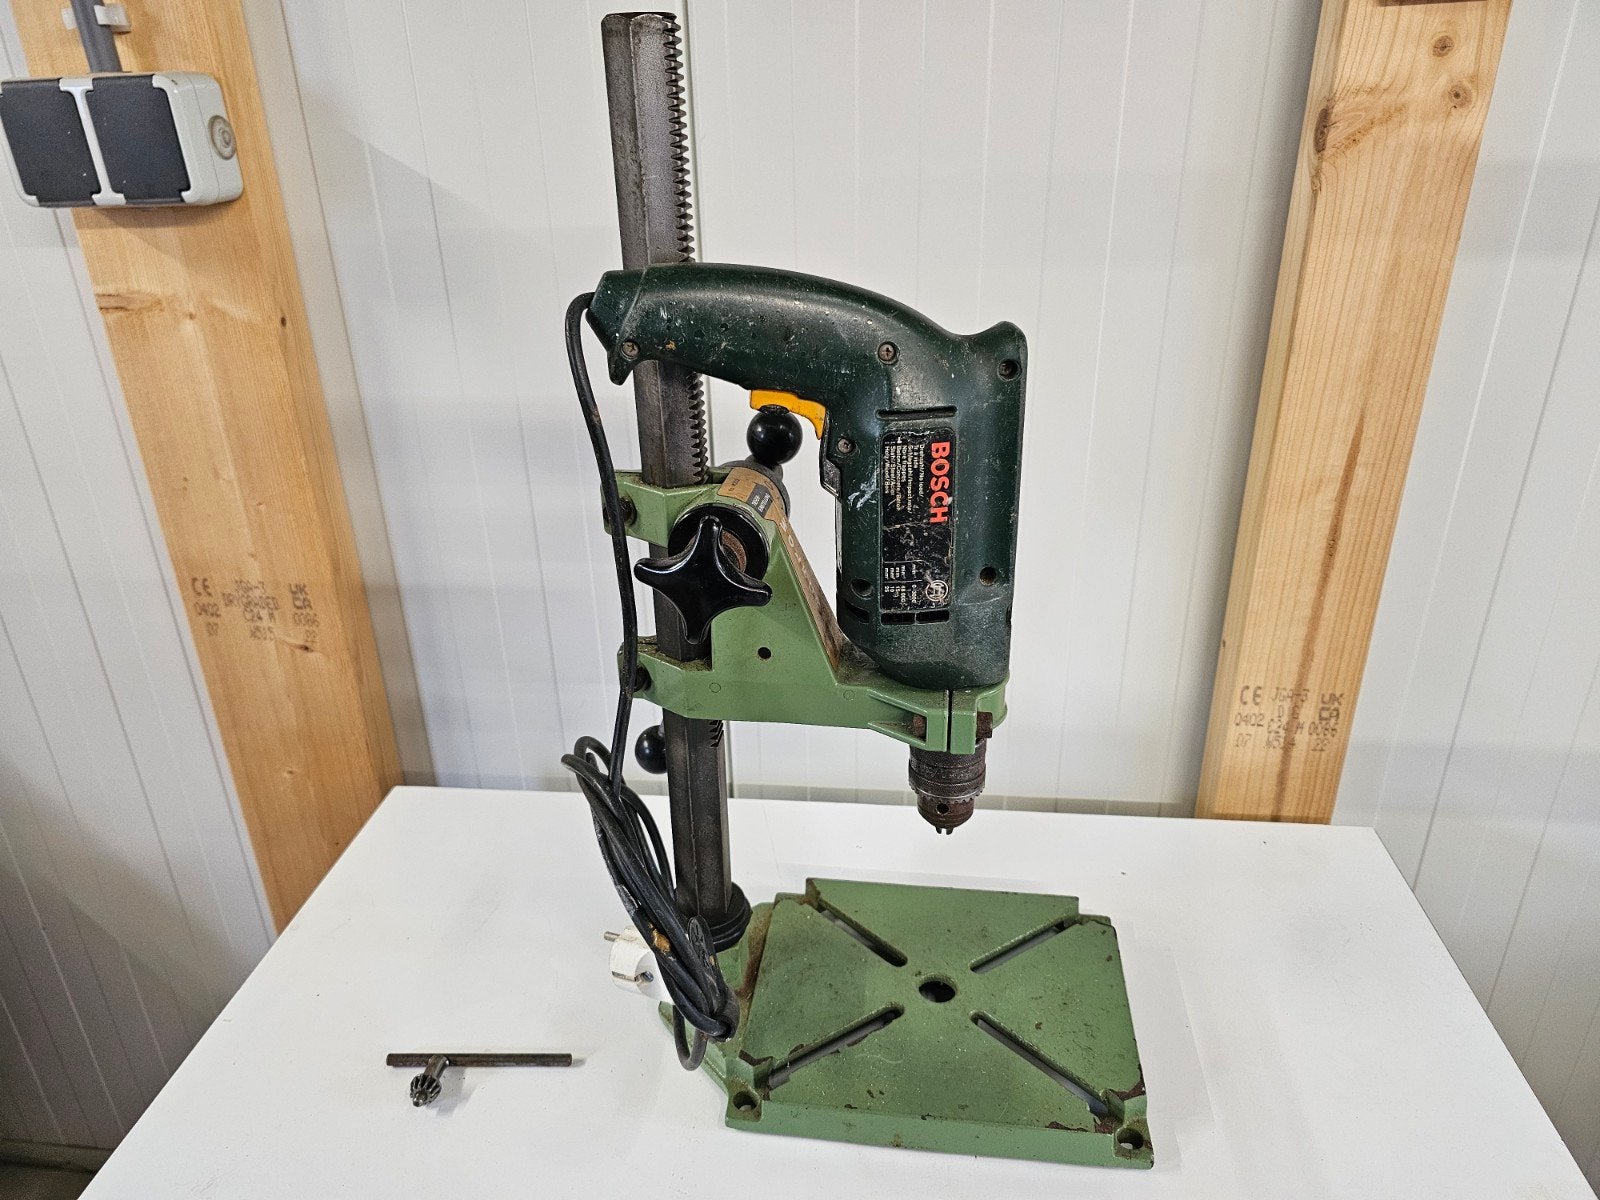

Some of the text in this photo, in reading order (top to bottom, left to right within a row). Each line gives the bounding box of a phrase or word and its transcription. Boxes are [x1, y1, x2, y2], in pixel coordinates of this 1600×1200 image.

[930, 442, 950, 523] BOSCH
[191, 577, 212, 597] CE
[1240, 685, 1262, 706] CE
[1321, 692, 1345, 706] UK
[1234, 712, 1265, 727] 0402
